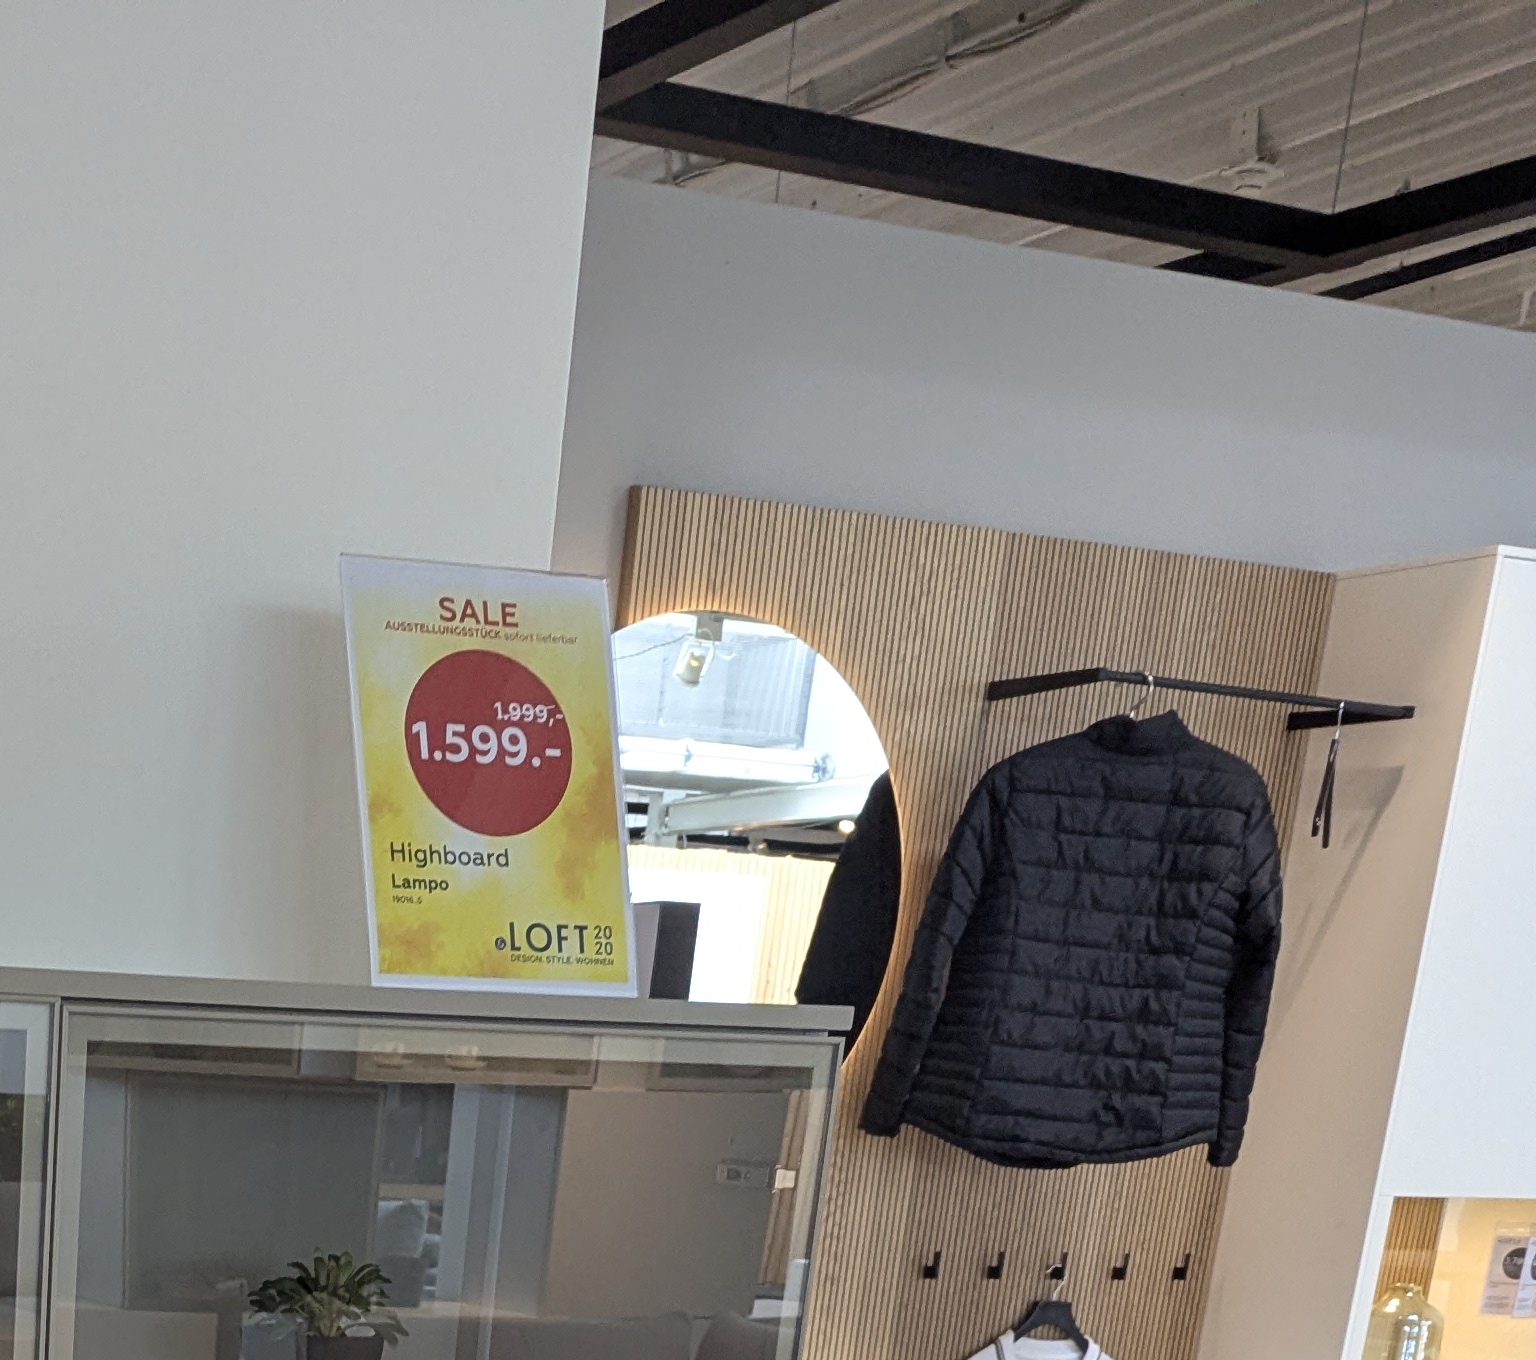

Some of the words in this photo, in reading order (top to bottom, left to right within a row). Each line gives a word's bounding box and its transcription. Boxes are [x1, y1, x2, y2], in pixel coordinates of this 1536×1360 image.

[438, 596, 519, 628] SALE
[384, 620, 502, 640] AUSSTELLUNGSSTÜCK
[411, 720, 562, 767] 1.599.-
[389, 841, 510, 869] Highboard
[391, 872, 450, 894] Lampo
[593, 924, 613, 940] 20
[594, 941, 614, 956] 20
